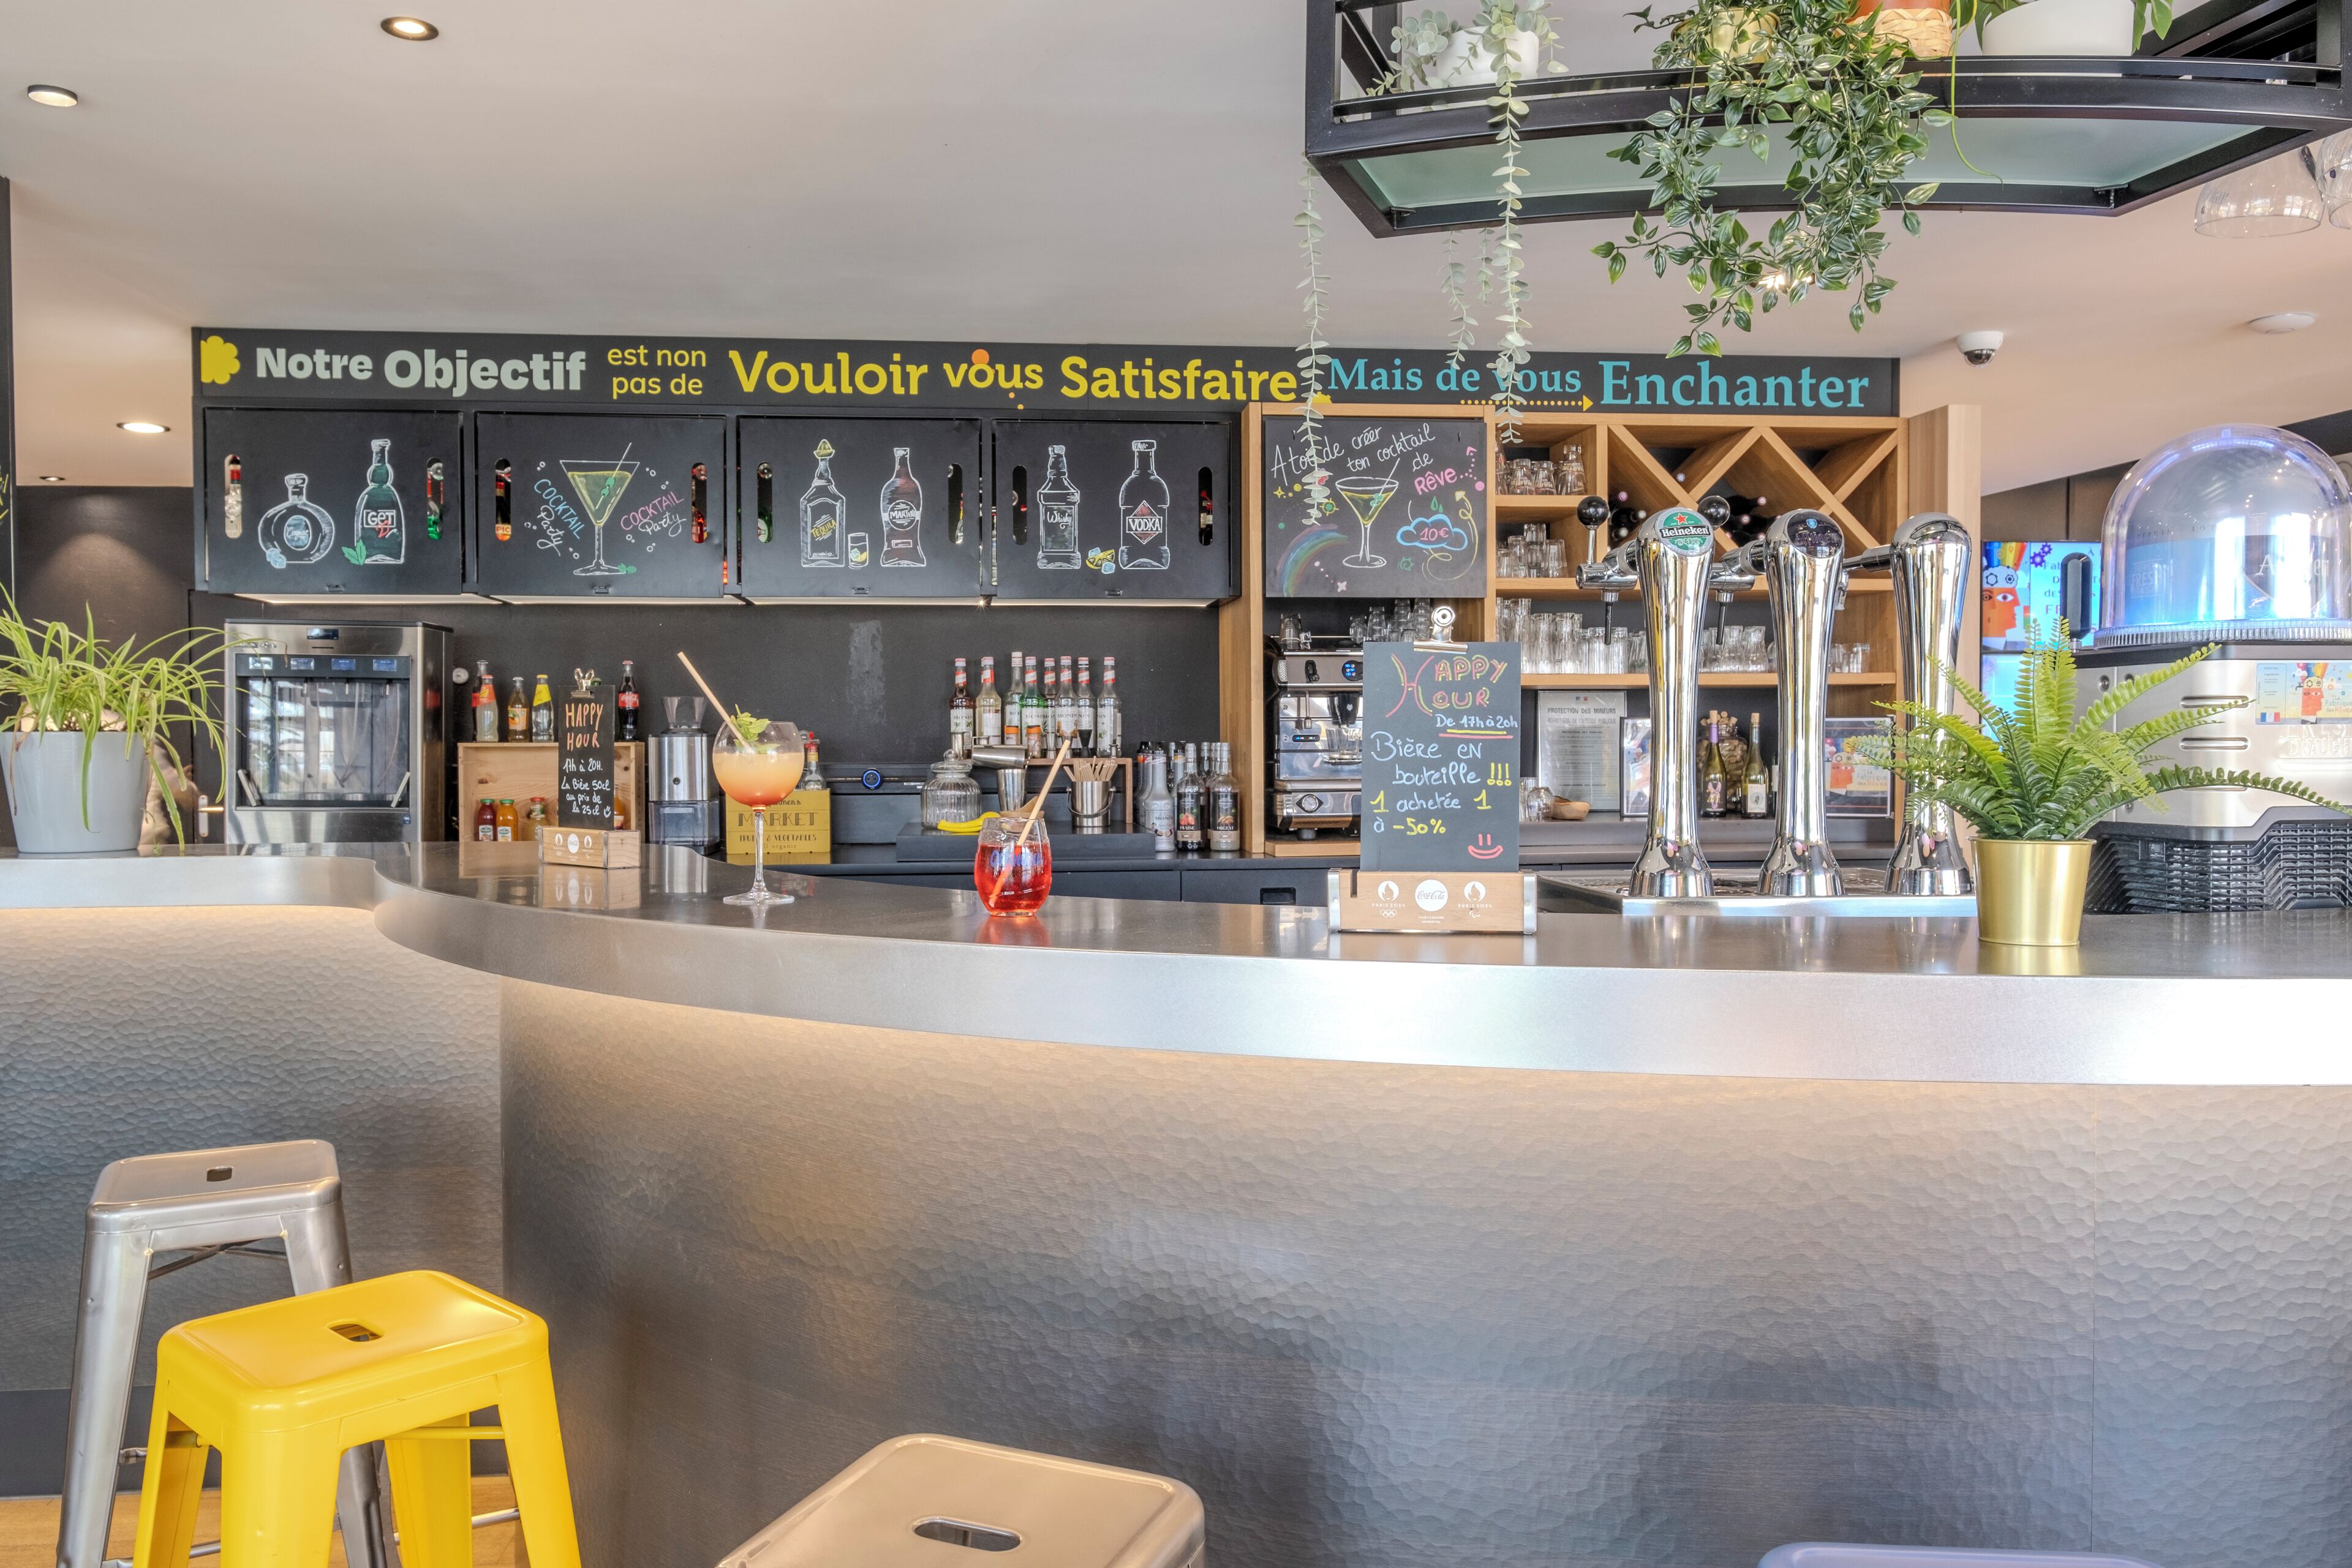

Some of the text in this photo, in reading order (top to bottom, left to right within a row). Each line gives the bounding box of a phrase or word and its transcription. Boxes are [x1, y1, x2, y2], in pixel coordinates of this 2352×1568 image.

[608, 345, 706, 367] est non
[256, 347, 586, 398] Notre Objectif
[728, 350, 1297, 401] Vouloir vous Satisfaire
[1327, 358, 1869, 408] Mais de vous Enchanter
[612, 373, 703, 399] pas de
[1323, 435, 1344, 461] de
[1347, 423, 1436, 473] ton cocktail
[1412, 452, 1434, 472] de
[1414, 468, 1457, 495] Rêve
[533, 478, 587, 540] COCKTAIL
[620, 491, 685, 531] COCKTAIL
[1047, 511, 1072, 529] Whisky
[537, 505, 563, 557] Party
[638, 511, 687, 537] Party
[810, 519, 837, 538] TEQUILA
[1128, 518, 1161, 532] VODKA
[1661, 526, 1709, 537] Heineken
[565, 703, 603, 731] HAPPY
[1435, 714, 1456, 728] De
[567, 732, 600, 752] HOUR
[579, 760, 586, 772] à
[1392, 761, 1512, 786] bouteille !!!
[561, 776, 611, 791] La Bière 50cl
[572, 801, 581, 813] la
[578, 793, 590, 805] prix
[592, 791, 602, 804] de
[1370, 788, 1492, 813] 1 achetée 1
[1373, 816, 1385, 834] à
